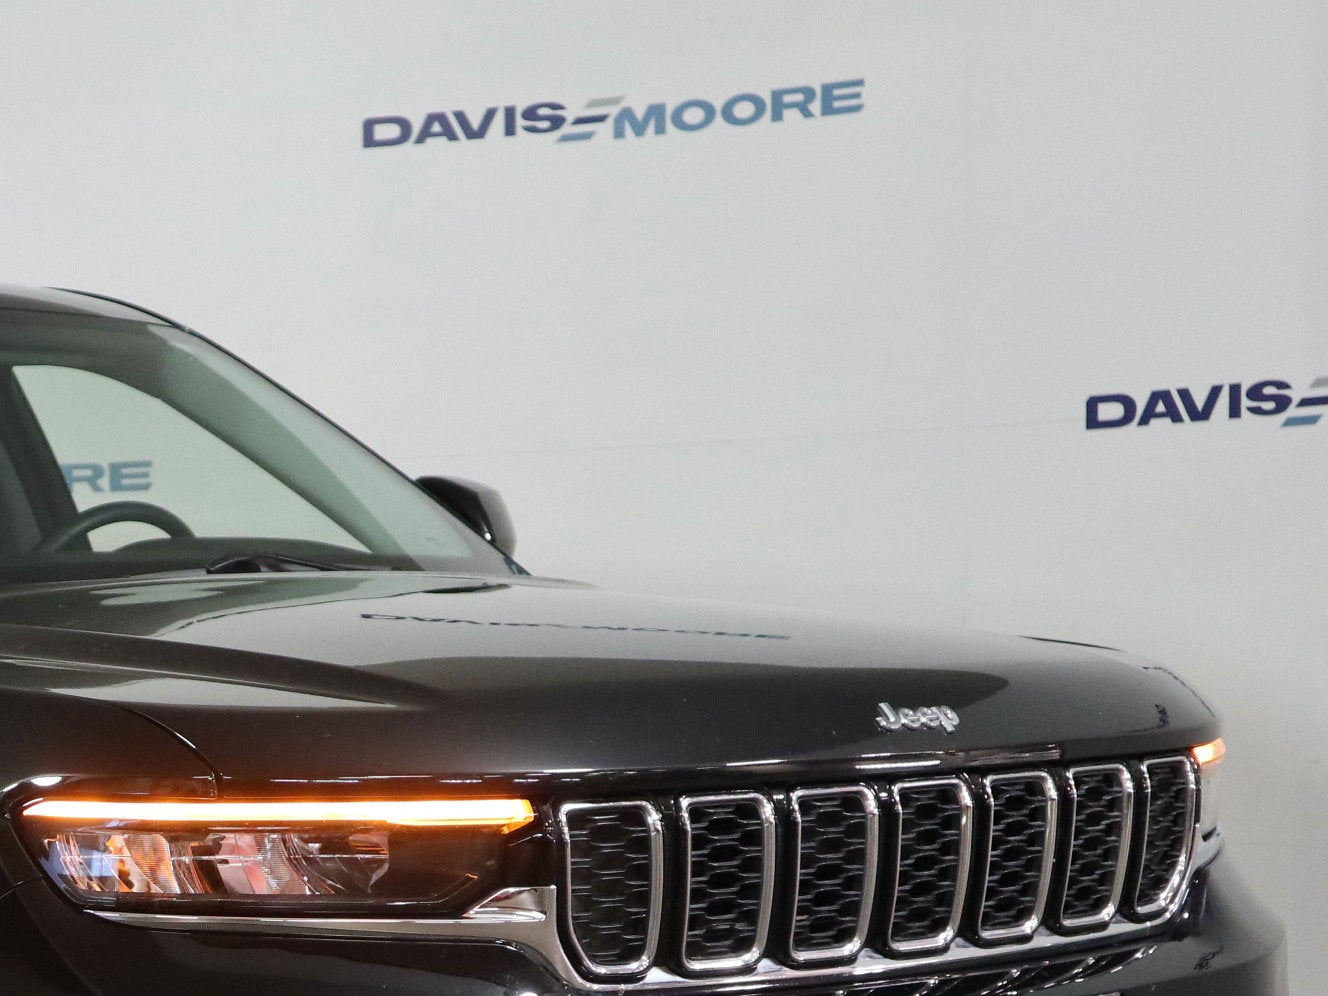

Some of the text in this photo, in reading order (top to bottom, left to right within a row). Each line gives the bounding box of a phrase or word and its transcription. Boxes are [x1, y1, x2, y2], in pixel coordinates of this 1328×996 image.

[362, 78, 866, 149] DAVIS MOORE
[1085, 379, 1293, 430] DAVIS
[875, 702, 960, 734] Jeep
